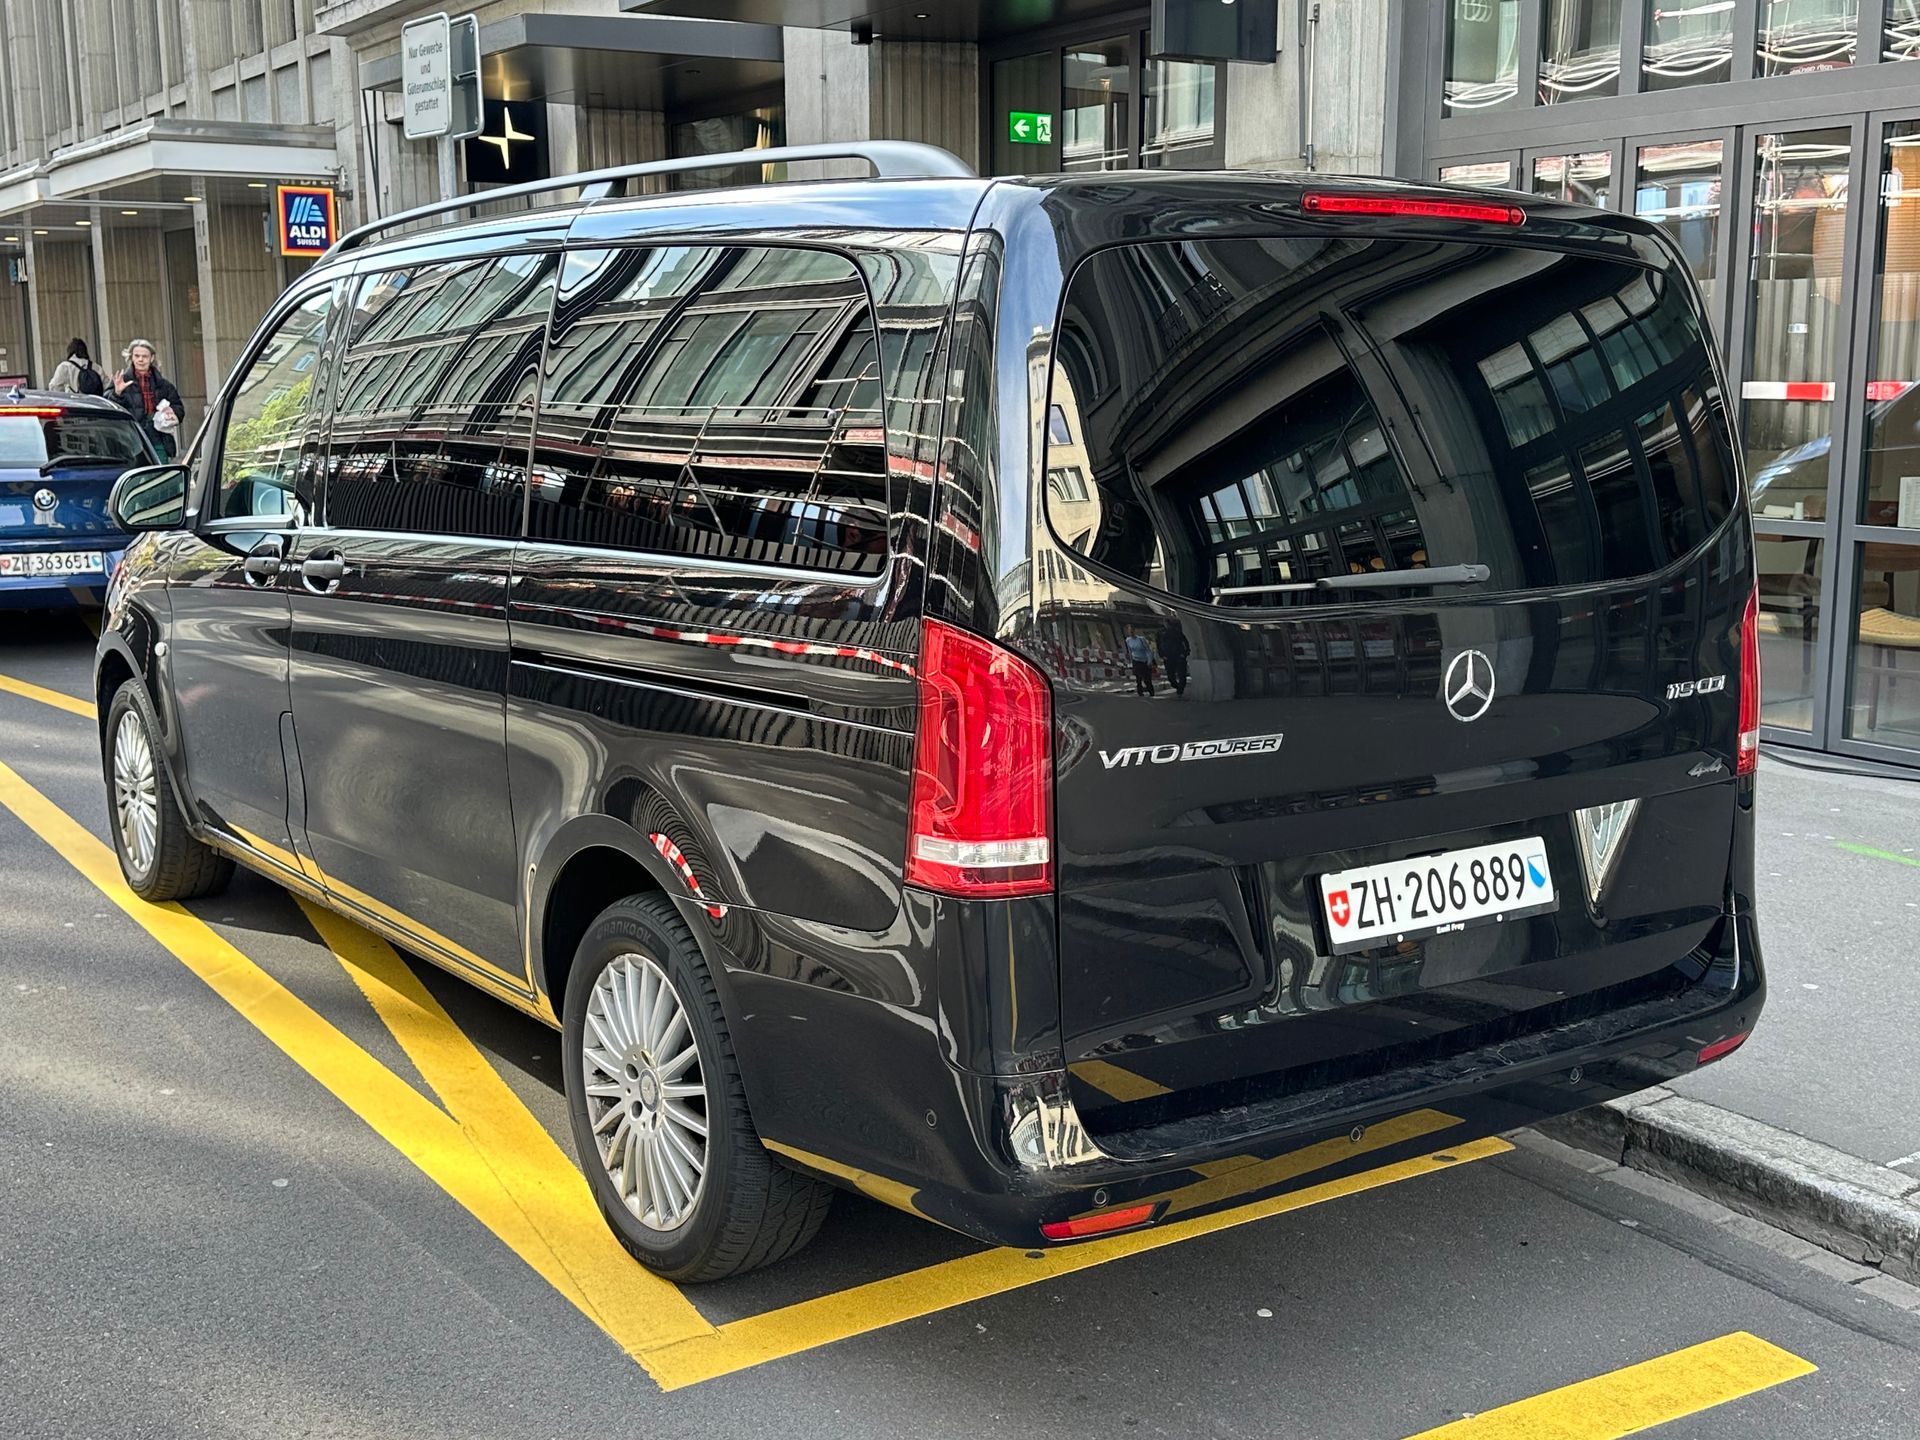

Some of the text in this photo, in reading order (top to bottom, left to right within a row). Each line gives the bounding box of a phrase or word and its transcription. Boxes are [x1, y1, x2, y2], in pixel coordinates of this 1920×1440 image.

[408, 41, 443, 59] Nur Gewerbe
[420, 60, 431, 75] und
[407, 76, 446, 96] Güterumschlag
[414, 97, 439, 116] gestattet
[289, 225, 327, 239] ALDI
[296, 238, 321, 247] SUISSE
[1098, 737, 1278, 770] VITO TOURER
